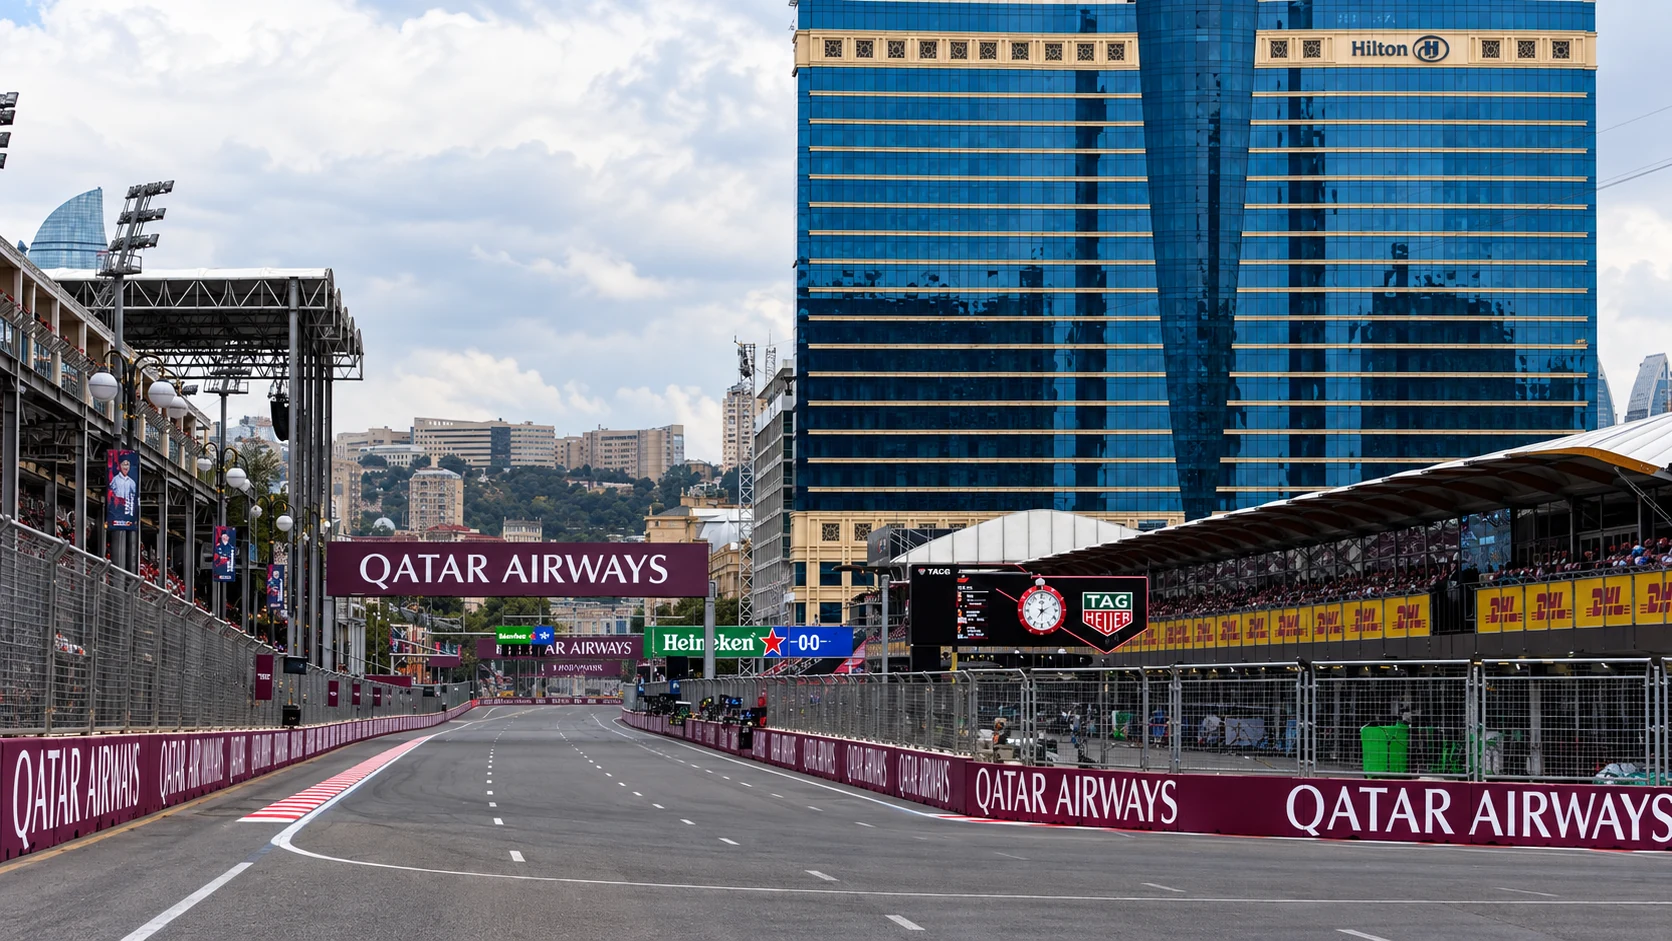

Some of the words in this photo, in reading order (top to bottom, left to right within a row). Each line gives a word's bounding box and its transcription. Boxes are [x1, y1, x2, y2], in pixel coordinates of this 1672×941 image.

[1352, 41, 1408, 56] Hilton
[359, 553, 490, 590] QATAR
[502, 554, 668, 584] AIRWAYS
[1086, 595, 1128, 608] TAG
[1490, 596, 1519, 623] DHL
[1536, 592, 1567, 621] DHL
[1592, 586, 1624, 617] DHL
[1648, 582, 1672, 613] DH
[1086, 612, 1130, 632] HEUER
[1397, 604, 1423, 629] DHL
[570, 641, 633, 655] AIRWAYS
[160, 740, 186, 805] QATAR
[13, 749, 81, 850] QATAR
[85, 743, 140, 820] AIRWAYS
[976, 767, 1048, 816] QATAR
[1055, 774, 1178, 825] AIRWAYS
[1286, 784, 1455, 836] QATAR
[1469, 789, 1672, 843] AIRWAYS
